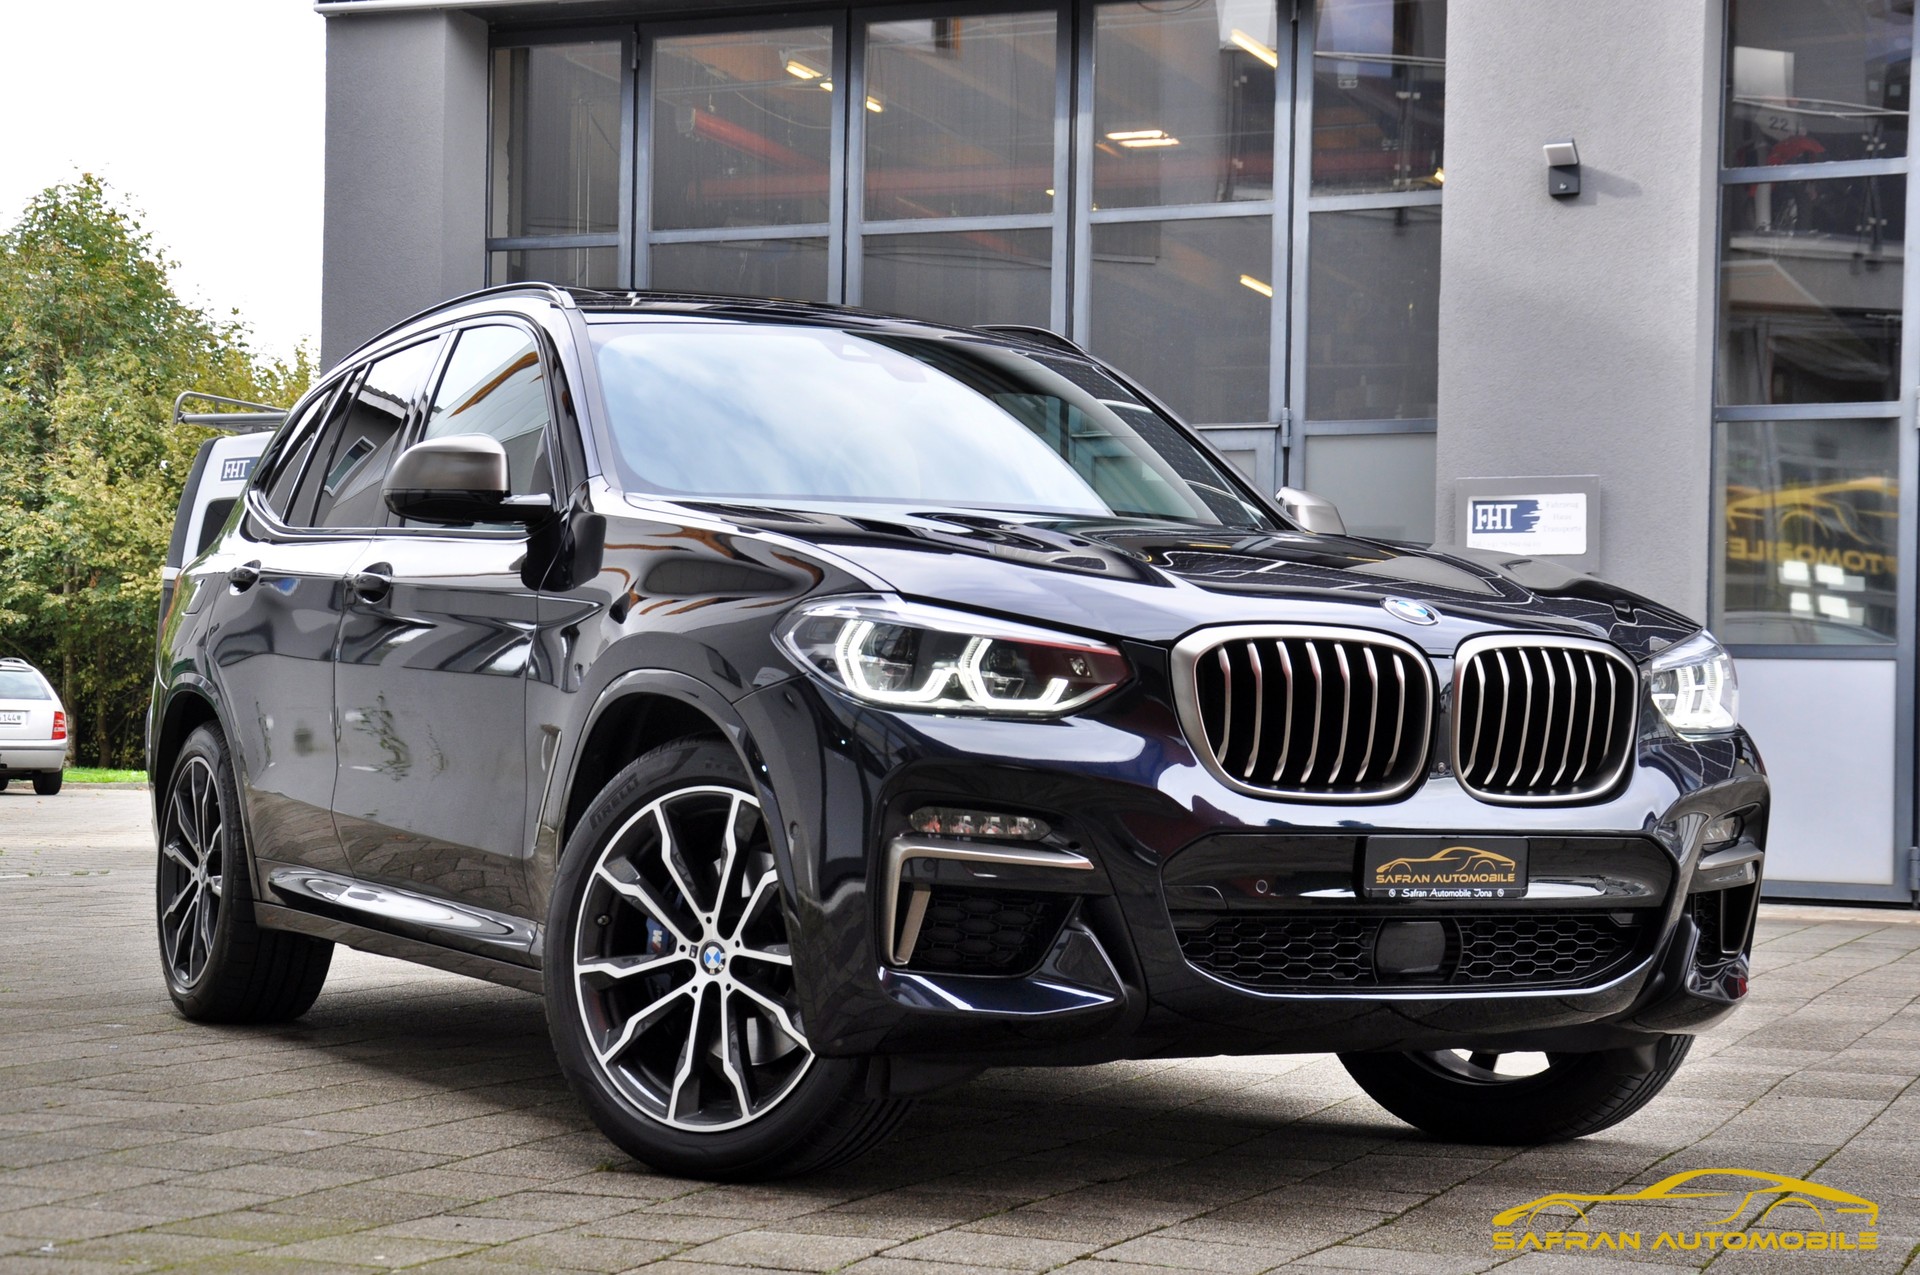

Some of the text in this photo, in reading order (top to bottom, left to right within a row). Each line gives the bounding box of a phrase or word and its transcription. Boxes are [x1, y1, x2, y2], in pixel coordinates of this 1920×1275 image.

[222, 459, 251, 479] FHT
[1475, 504, 1518, 530] FHT
[0, 713, 17, 722] 144
[589, 772, 640, 830] PIRELLI
[1375, 873, 1516, 884] SAFRAN AUTOMOBILE
[1401, 888, 1493, 898] Safran Automobile Jona
